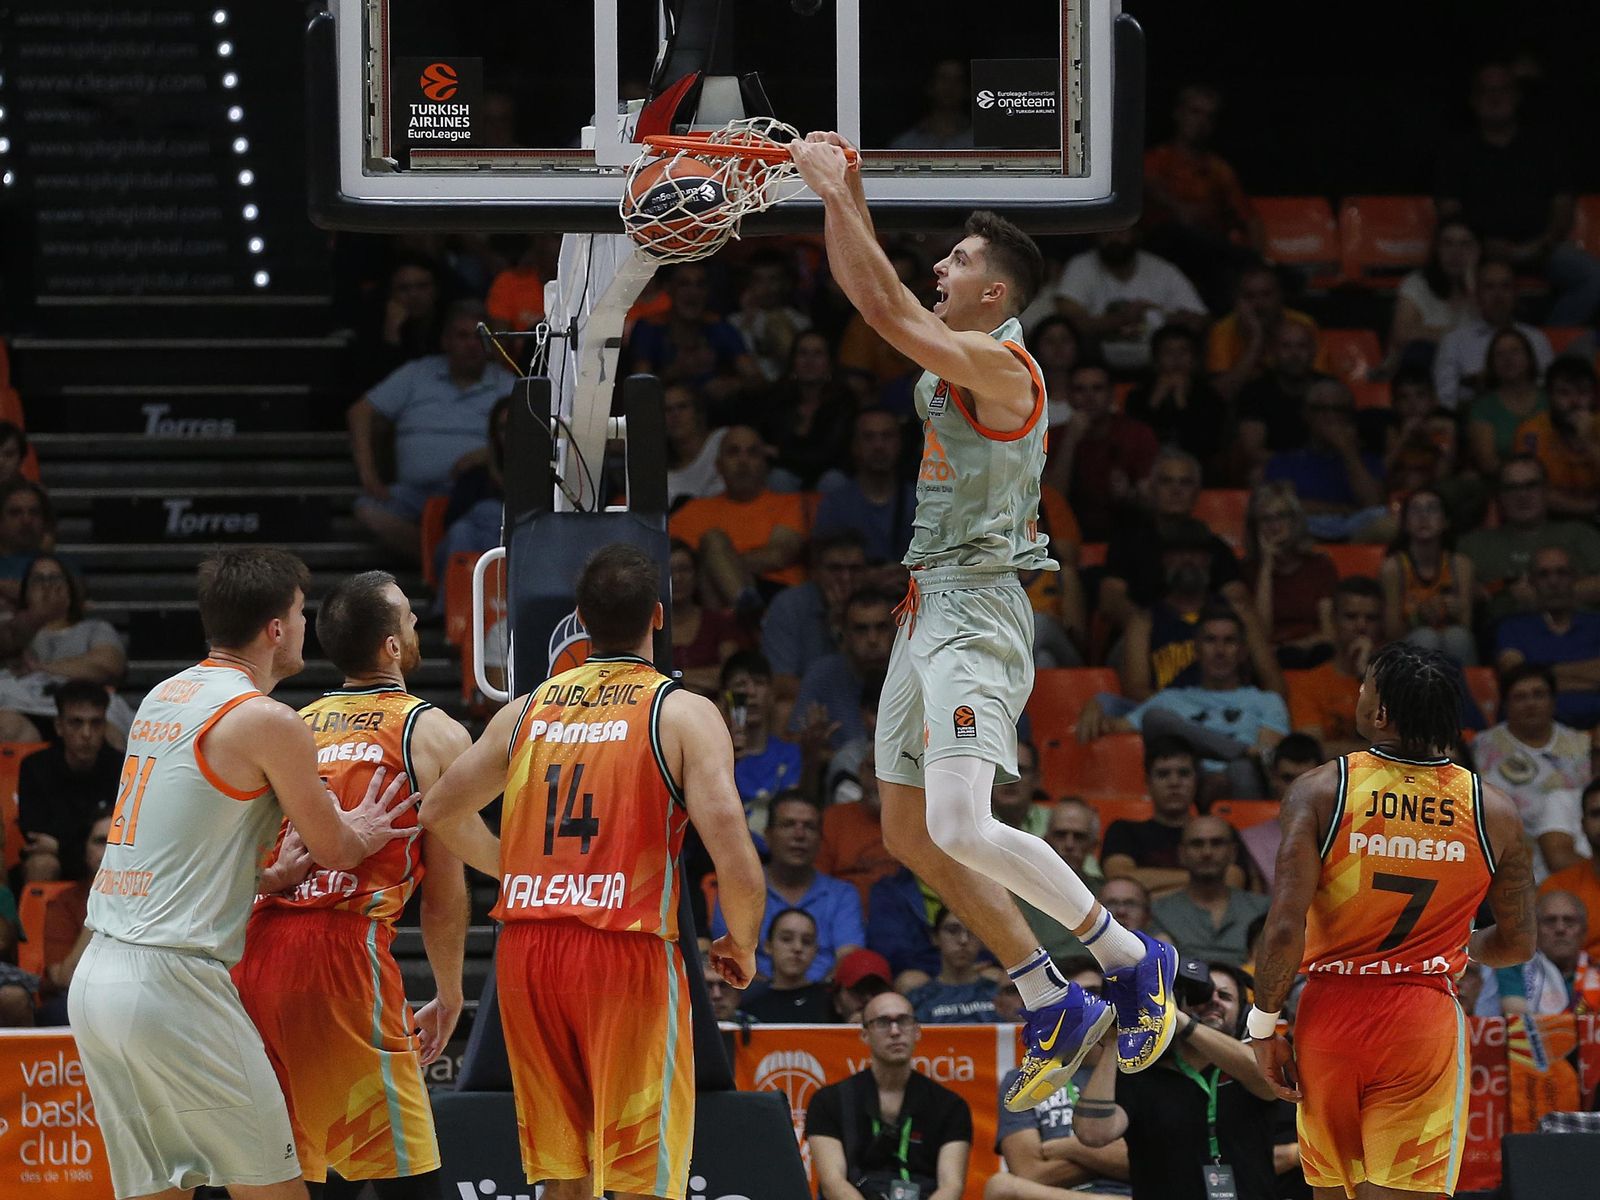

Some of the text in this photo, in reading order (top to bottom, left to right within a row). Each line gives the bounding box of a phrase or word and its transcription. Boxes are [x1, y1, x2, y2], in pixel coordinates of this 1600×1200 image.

[409, 104, 470, 115] TURKISH
[997, 96, 1055, 108] oneteam
[407, 129, 471, 142] EuroLeague
[409, 116, 470, 128] AIRLINES
[142, 403, 236, 438] Torres
[162, 499, 259, 534] Torres
[529, 719, 630, 744] PAMESA
[107, 754, 157, 847] 21
[543, 763, 600, 856] 14
[1365, 790, 1456, 827] JONES
[1349, 831, 1466, 862] PAMESA
[1371, 871, 1439, 953] 7
[19, 1130, 93, 1167] club
